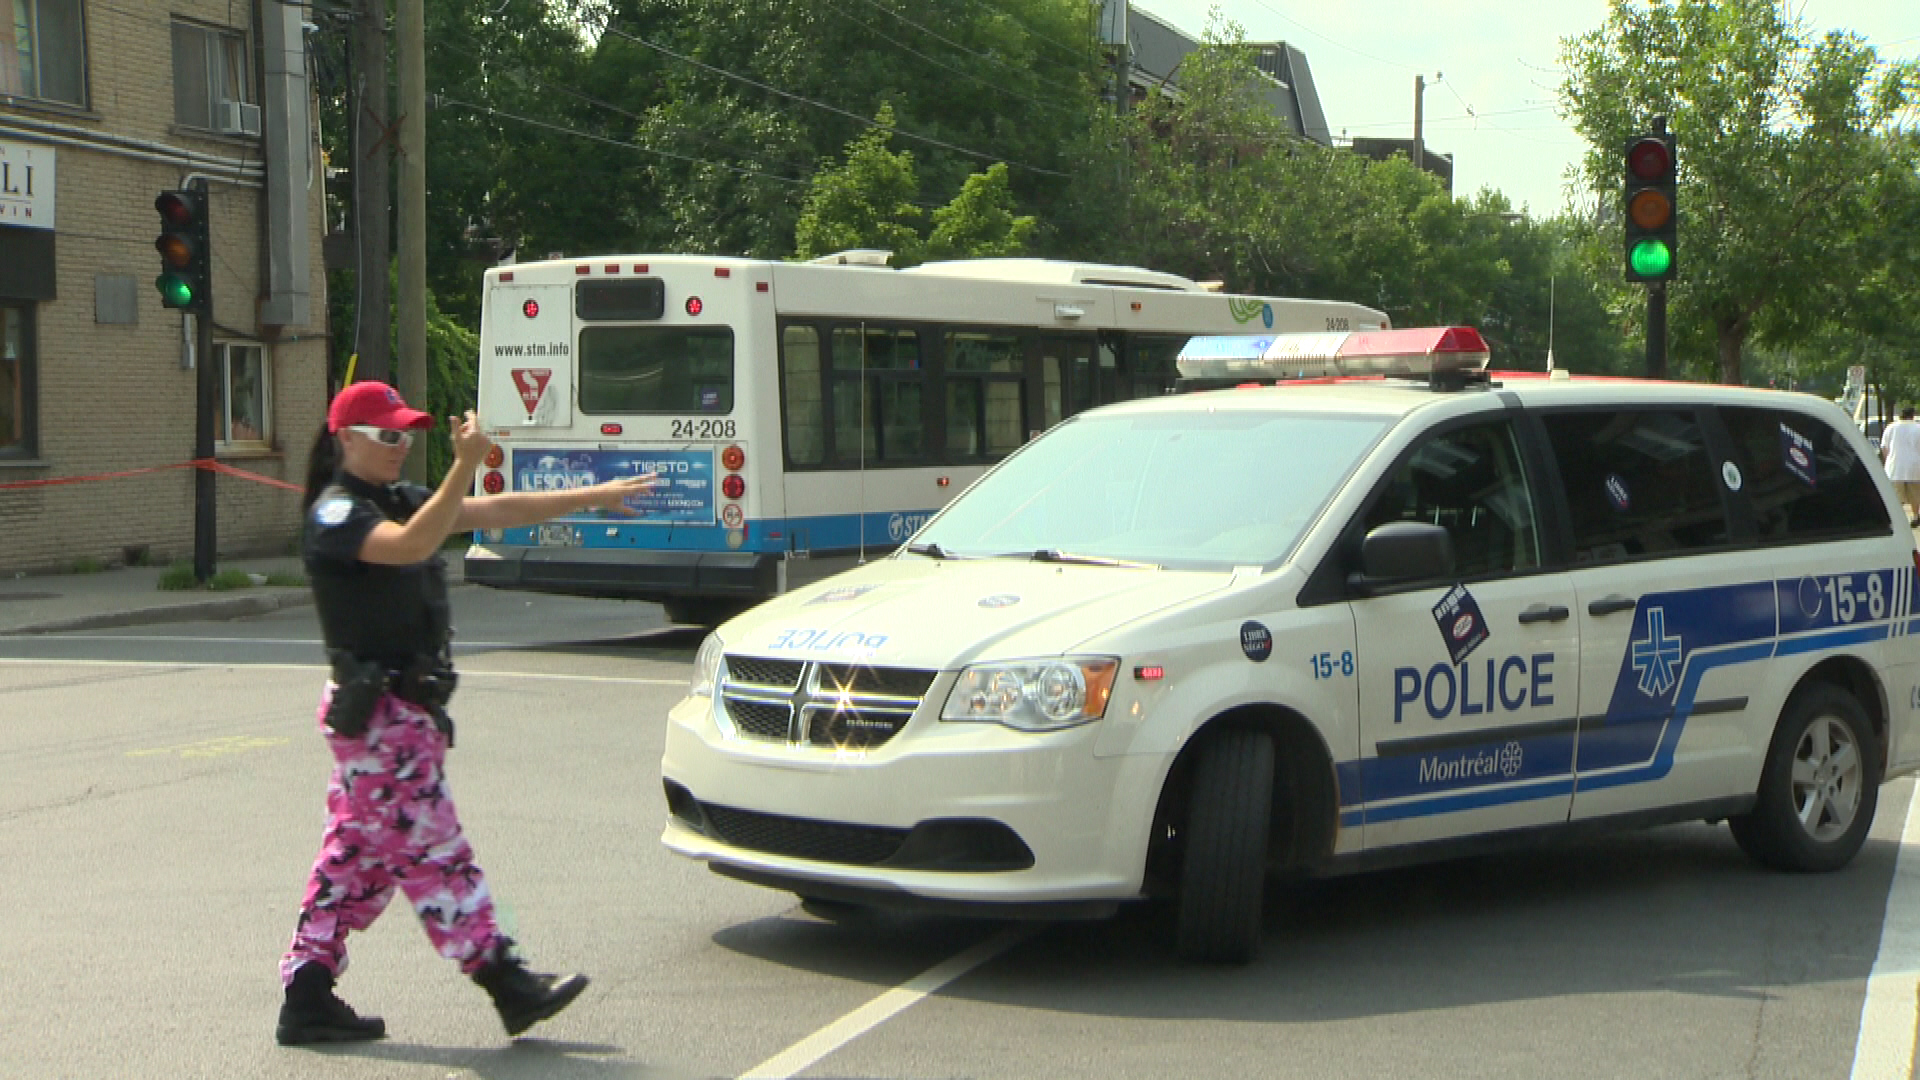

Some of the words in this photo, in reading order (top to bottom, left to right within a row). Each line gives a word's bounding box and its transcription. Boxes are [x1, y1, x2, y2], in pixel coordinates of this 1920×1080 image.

[494, 341, 569, 357] www.stm.info
[671, 419, 736, 439] 24-208
[1823, 572, 1884, 623] 15-8
[1309, 649, 1354, 680] 15-8
[1394, 652, 1555, 725] POLICE
[1419, 747, 1499, 784] Montréal
